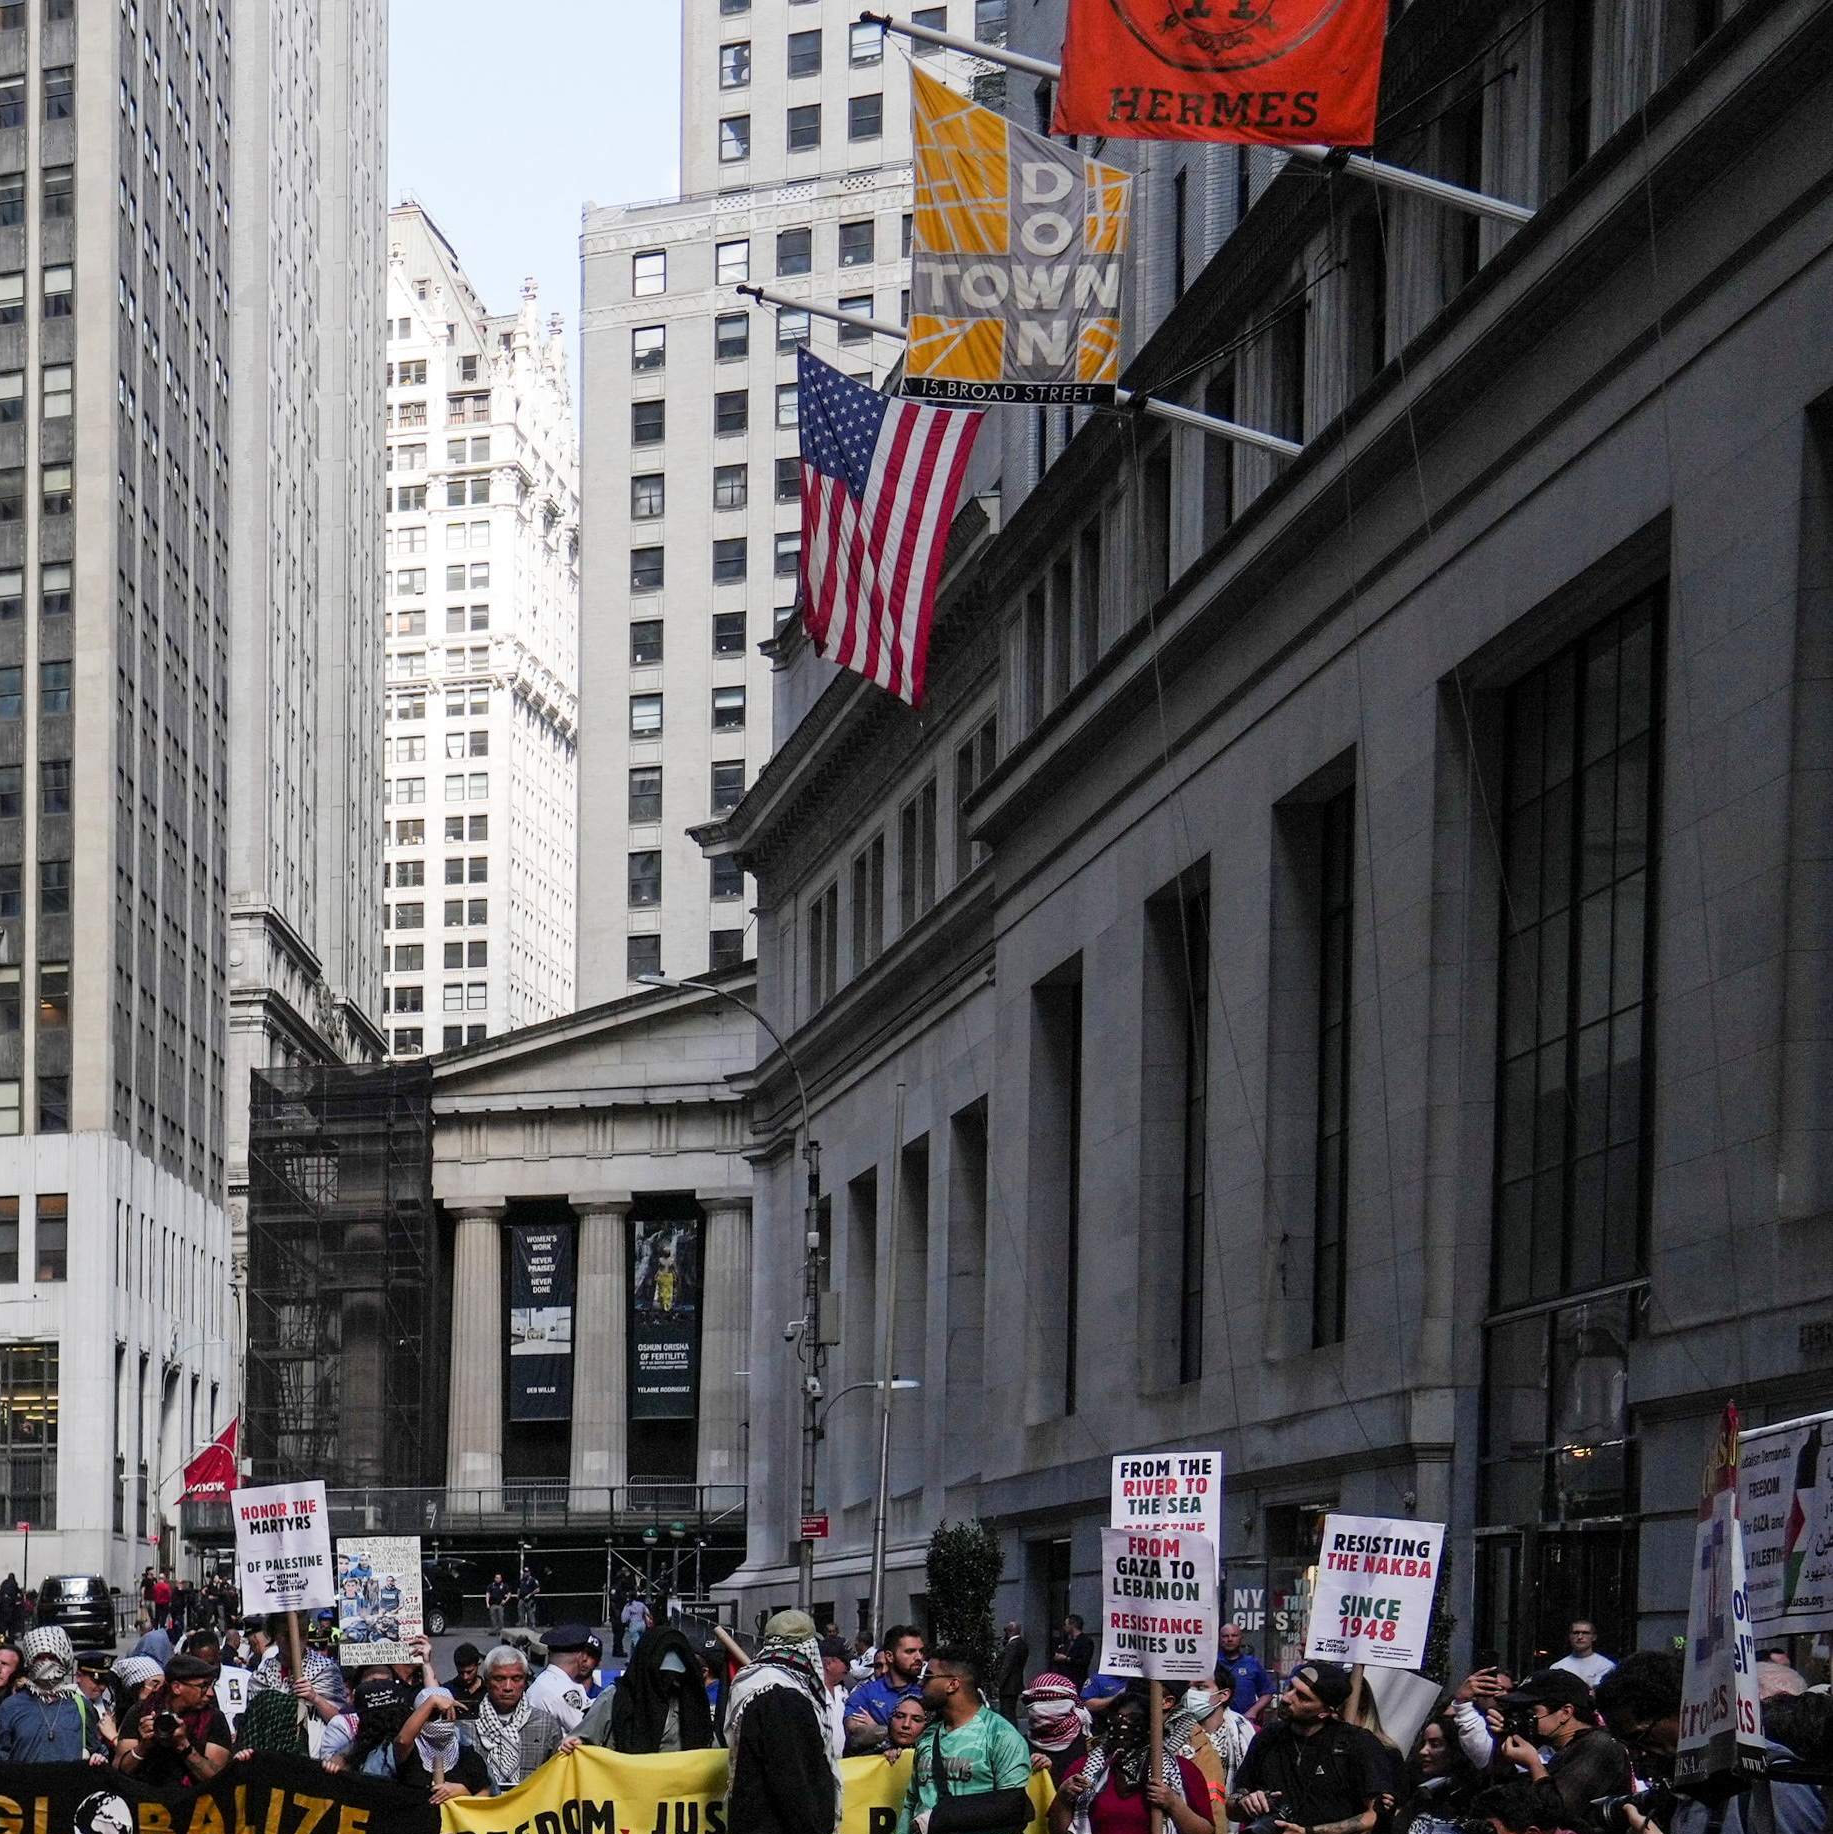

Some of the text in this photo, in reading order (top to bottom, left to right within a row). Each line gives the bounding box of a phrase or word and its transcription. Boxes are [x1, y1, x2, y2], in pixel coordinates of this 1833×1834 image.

[947, 381, 1096, 403] BROAD STREET
[526, 1235, 558, 1244] WOMEN'S
[528, 1265, 555, 1273] PRAISED
[531, 1257, 553, 1265] NEVER
[531, 1278, 553, 1286] NEVER
[533, 1286, 551, 1294] DONE
[663, 1343, 690, 1351] ORISHA
[1120, 1459, 1213, 1479] FROM THE
[1123, 1477, 1208, 1497] RIVER TO
[1748, 1476, 1780, 1500] FREEDOM
[240, 1499, 317, 1521] HONOR THE
[1128, 1497, 1202, 1515] THE SEA
[249, 1515, 311, 1535] MARTYRS
[1128, 1537, 1180, 1558] FROM
[1334, 1534, 1430, 1559] RESISTING
[247, 1560, 261, 1573] OF
[265, 1555, 323, 1572] PALESTINE
[1116, 1557, 1195, 1579] GAZA TO
[1327, 1553, 1432, 1578] THE NAKBA
[1113, 1577, 1200, 1602] LEBANON
[1234, 1589, 1264, 1609] NY
[1339, 1595, 1401, 1621] SINCE
[1110, 1612, 1203, 1635] RESISTANCE
[1339, 1617, 1397, 1642] 1948
[1116, 1632, 1197, 1654] UNITES US
